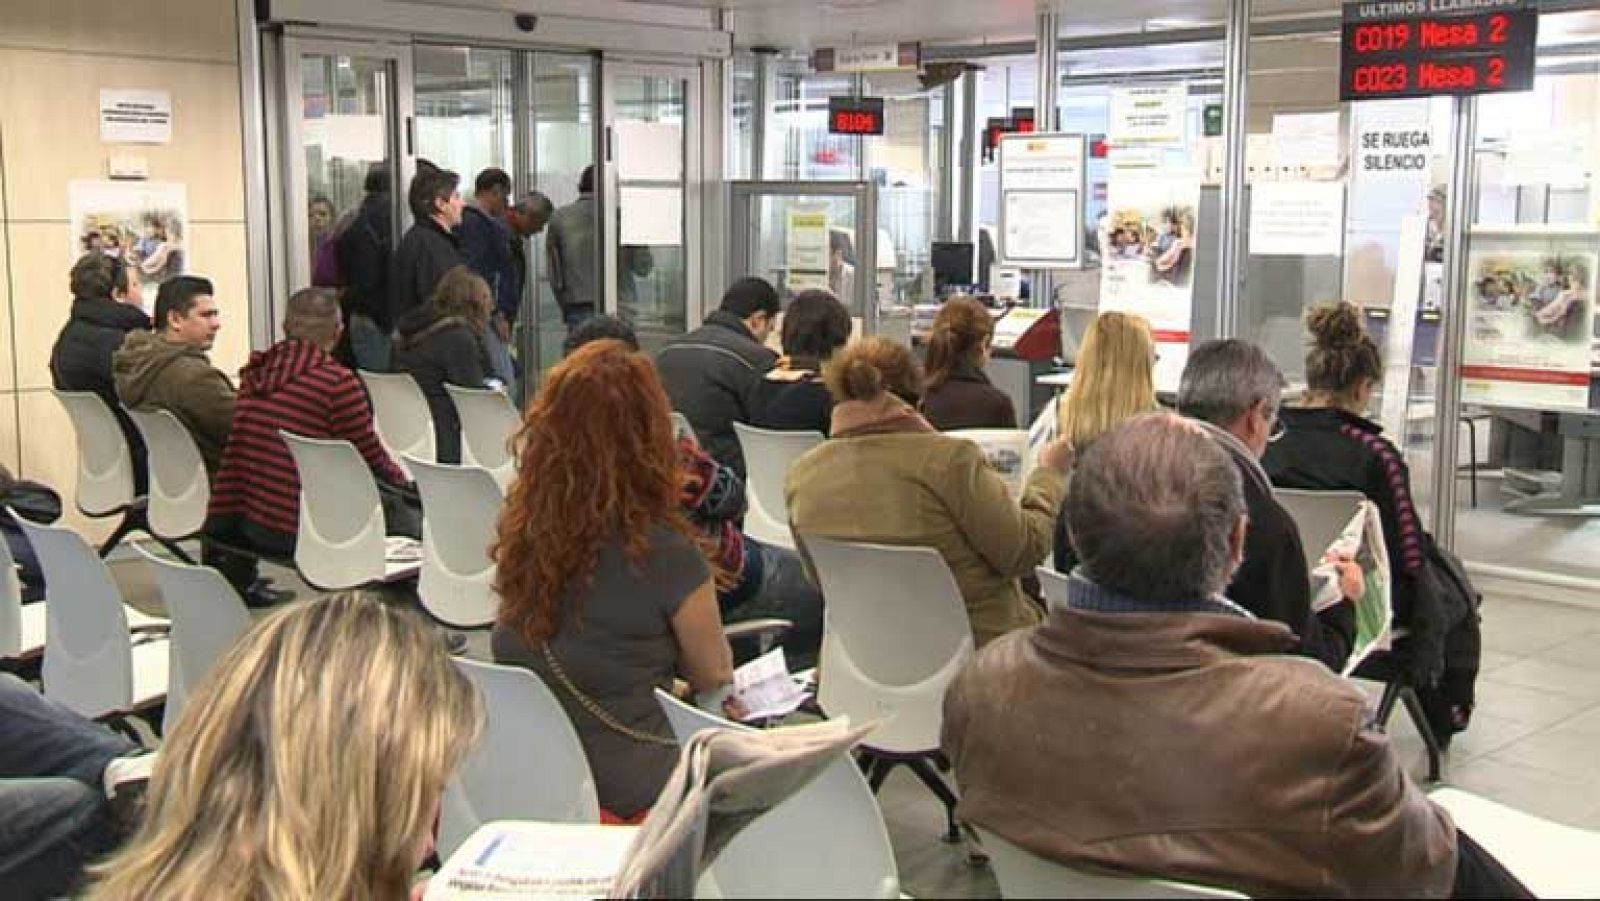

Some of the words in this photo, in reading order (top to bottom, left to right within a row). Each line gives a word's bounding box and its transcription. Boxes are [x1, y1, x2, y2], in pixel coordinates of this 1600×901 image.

[1420, 21, 1478, 48] Mesa
[1489, 15, 1509, 44] 2
[1418, 61, 1476, 90] Mesa
[1486, 57, 1506, 87] 2
[1362, 131, 1380, 148] SE
[1383, 130, 1430, 148] RUEGA
[1364, 153, 1426, 169] SILENCIO
